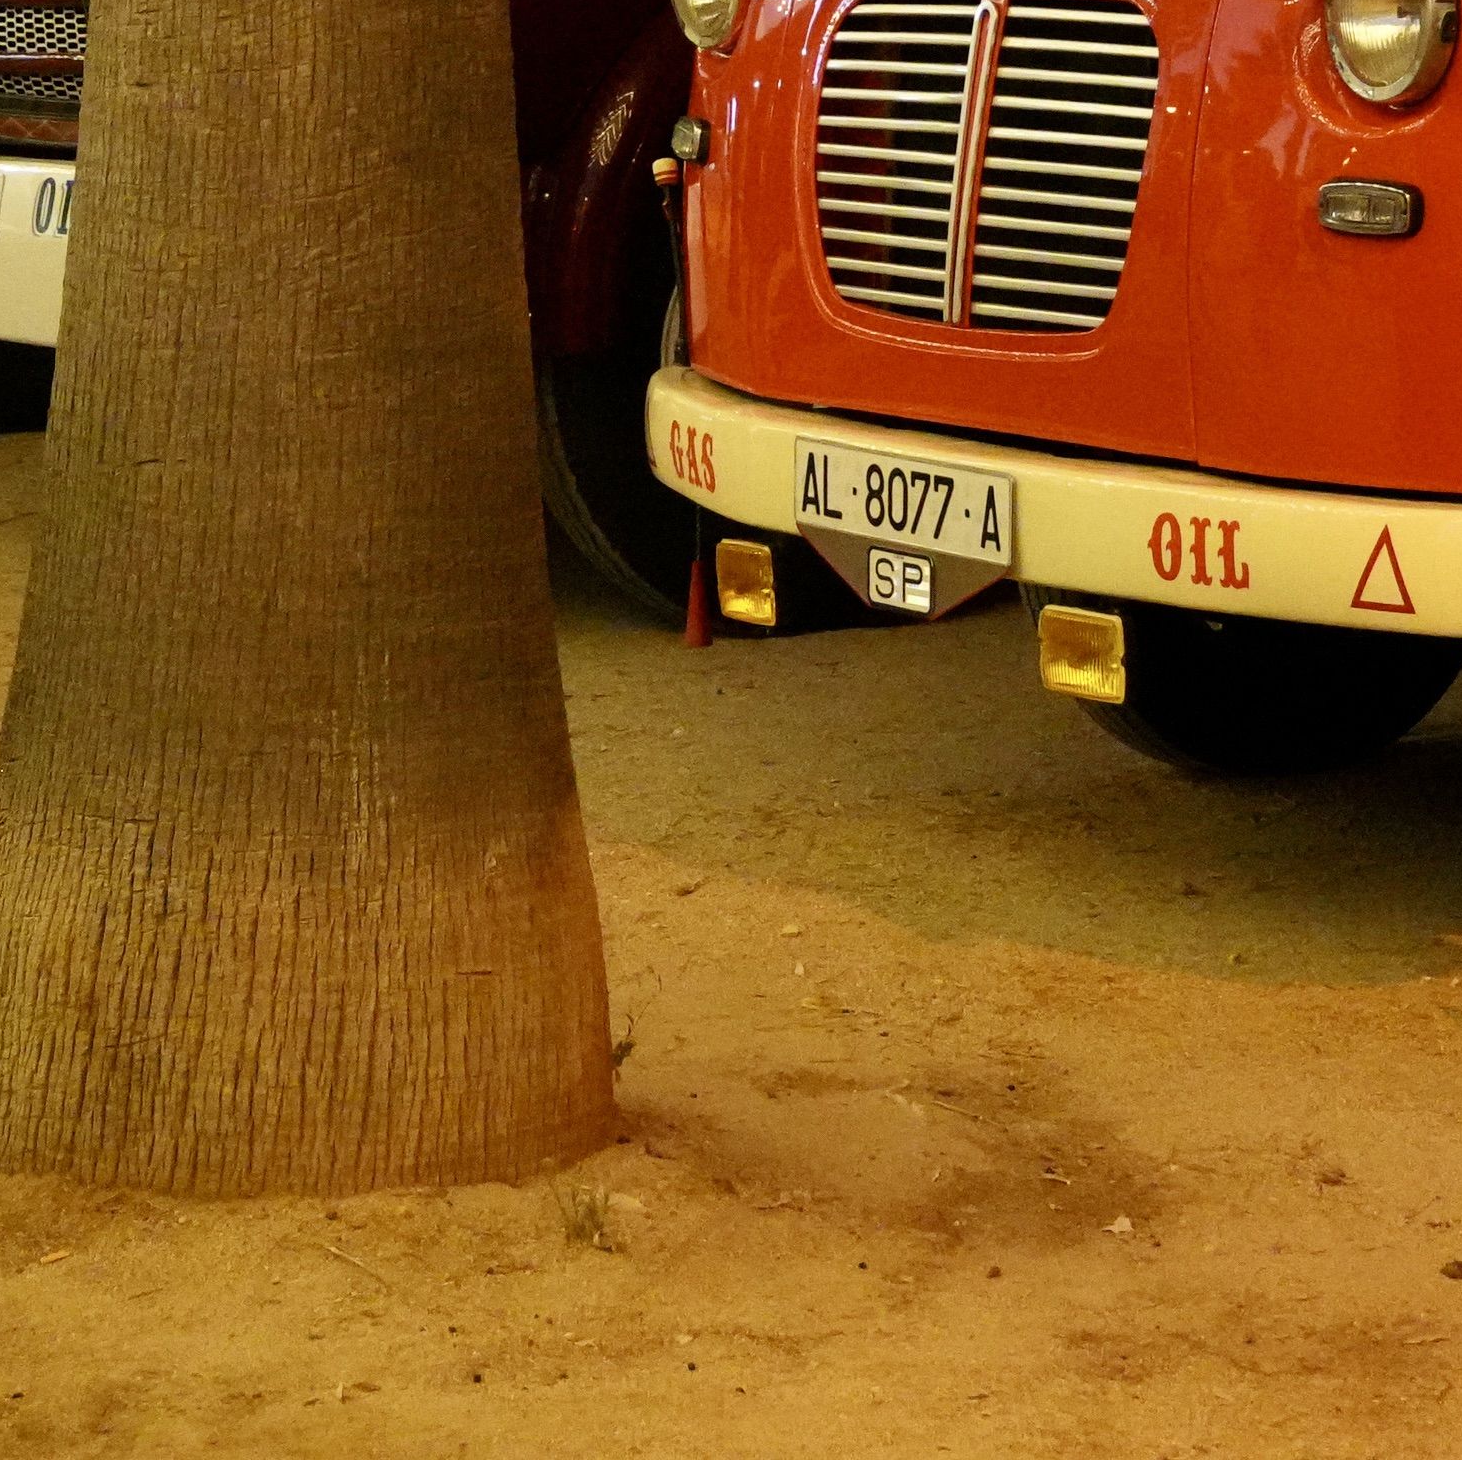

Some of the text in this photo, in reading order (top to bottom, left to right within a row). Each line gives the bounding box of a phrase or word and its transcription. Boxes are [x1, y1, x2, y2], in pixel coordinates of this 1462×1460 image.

[670, 419, 716, 494] GAS
[874, 557, 923, 604] SP
[1147, 511, 1250, 590] OIL
